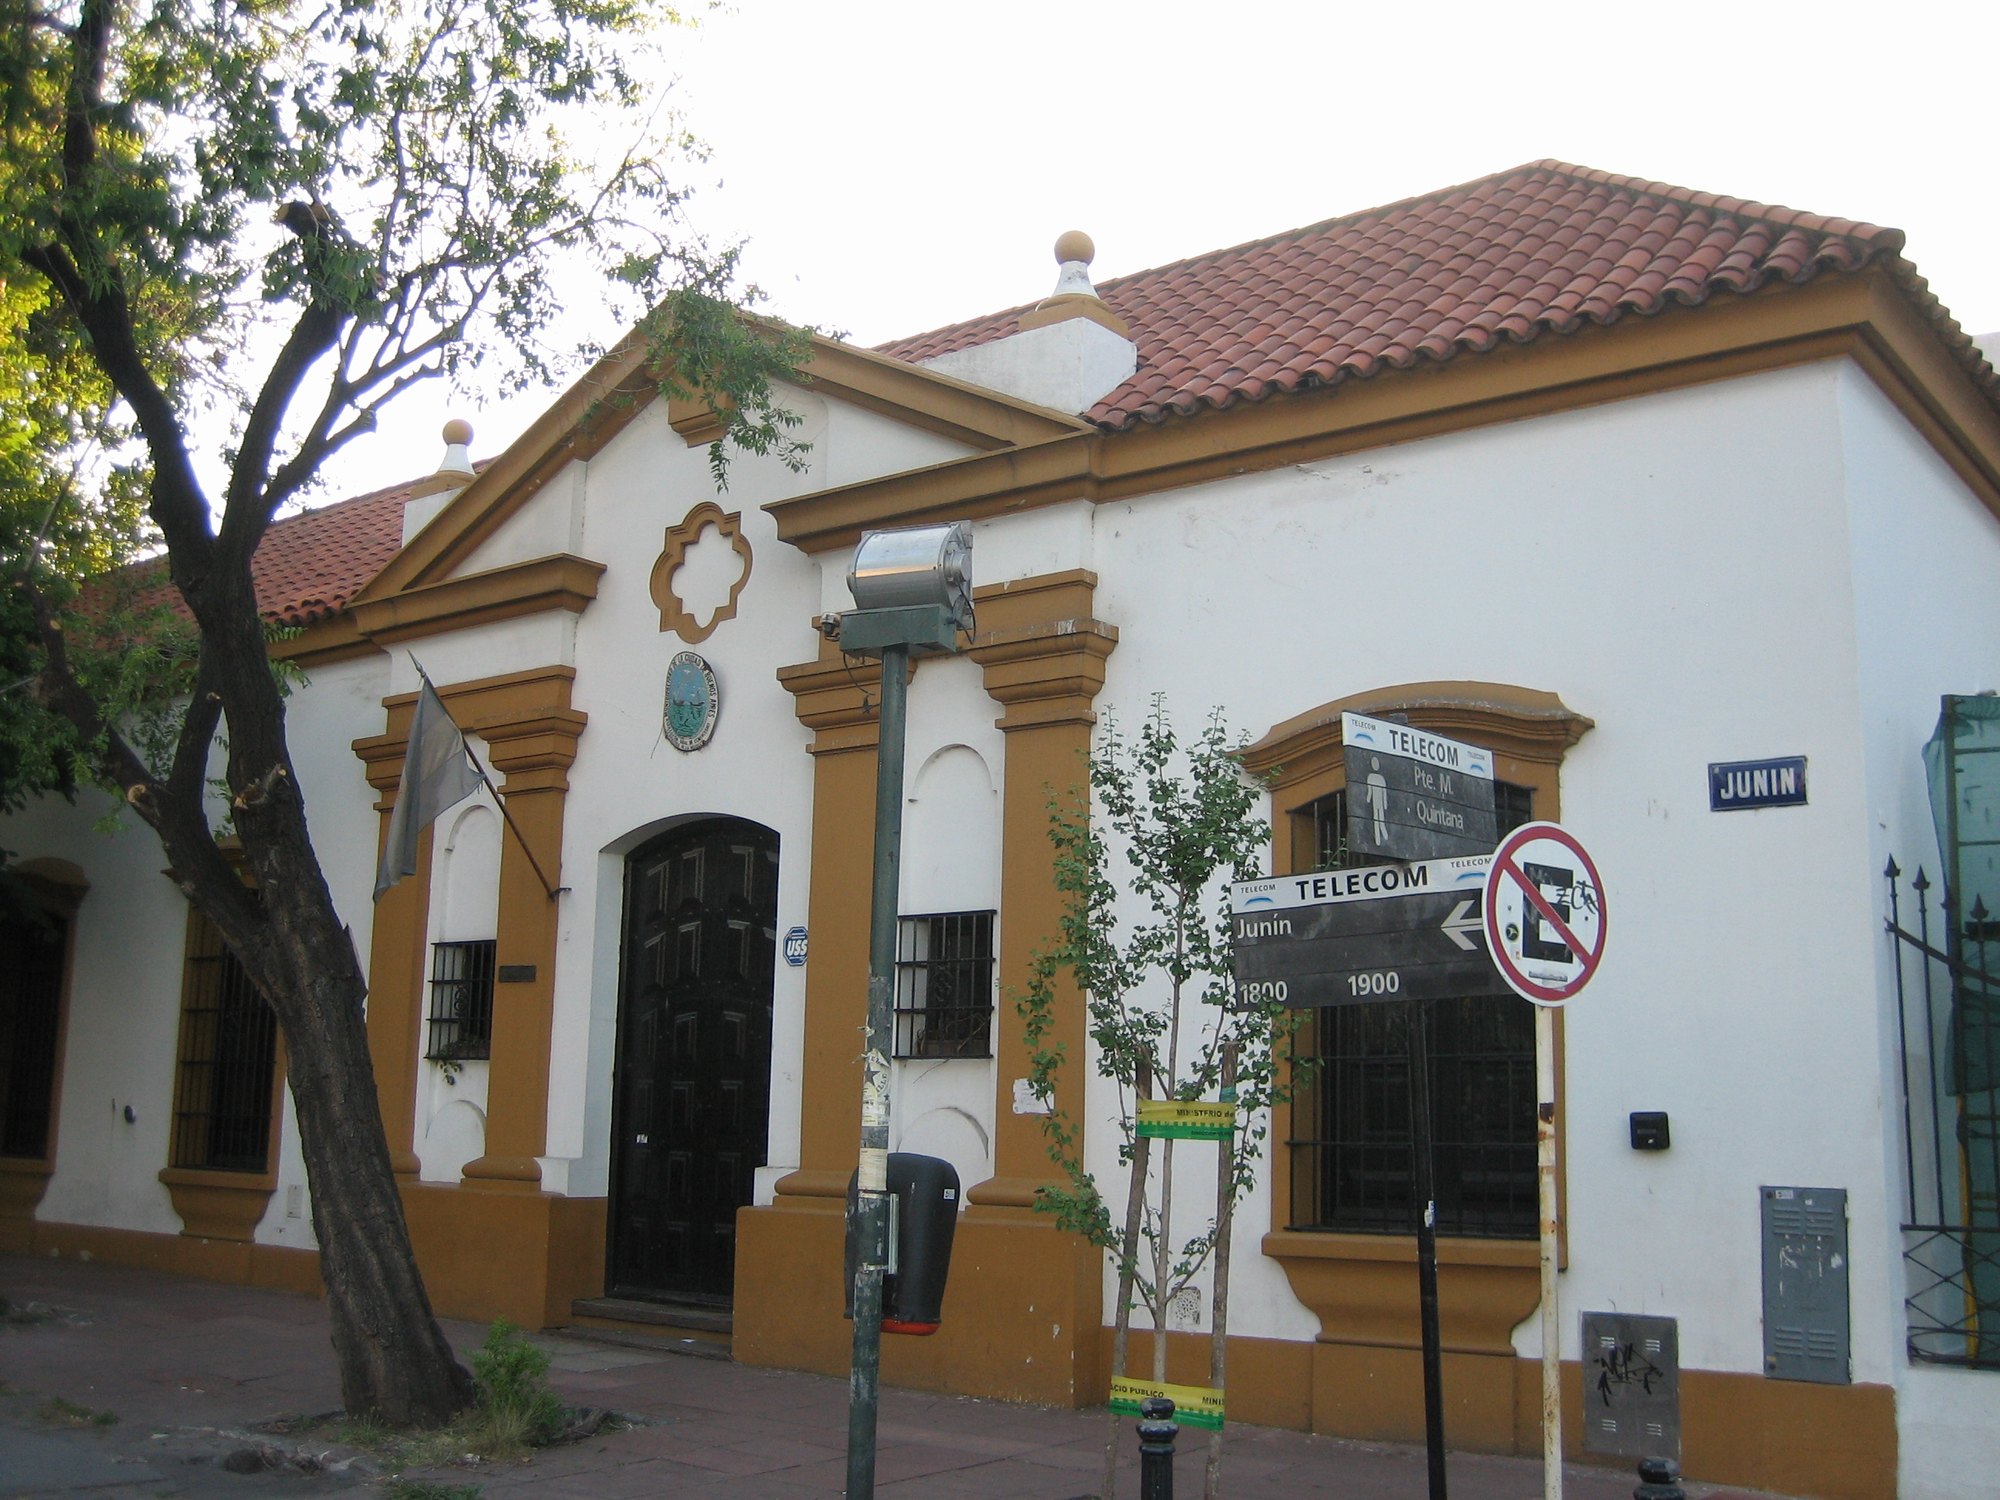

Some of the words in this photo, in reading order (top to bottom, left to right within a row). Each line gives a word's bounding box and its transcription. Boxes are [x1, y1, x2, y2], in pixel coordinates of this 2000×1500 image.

[1351, 719, 1377, 731] TELECOM
[1389, 729, 1459, 767] TELECOM
[1414, 765, 1436, 791] Pte.
[1439, 773, 1454, 795] M.
[1720, 767, 1796, 800] JUNIN
[1416, 800, 1464, 831] Quintana
[1450, 857, 1492, 869] TELECOM
[1241, 884, 1277, 895] TELECOM
[1295, 865, 1428, 900] TELECOM
[1237, 913, 1293, 939] Junín
[786, 939, 808, 957] USS
[1239, 980, 1289, 1005] 1800
[1347, 971, 1400, 997] 1900
[1130, 1387, 1164, 1398] PUBLICO
